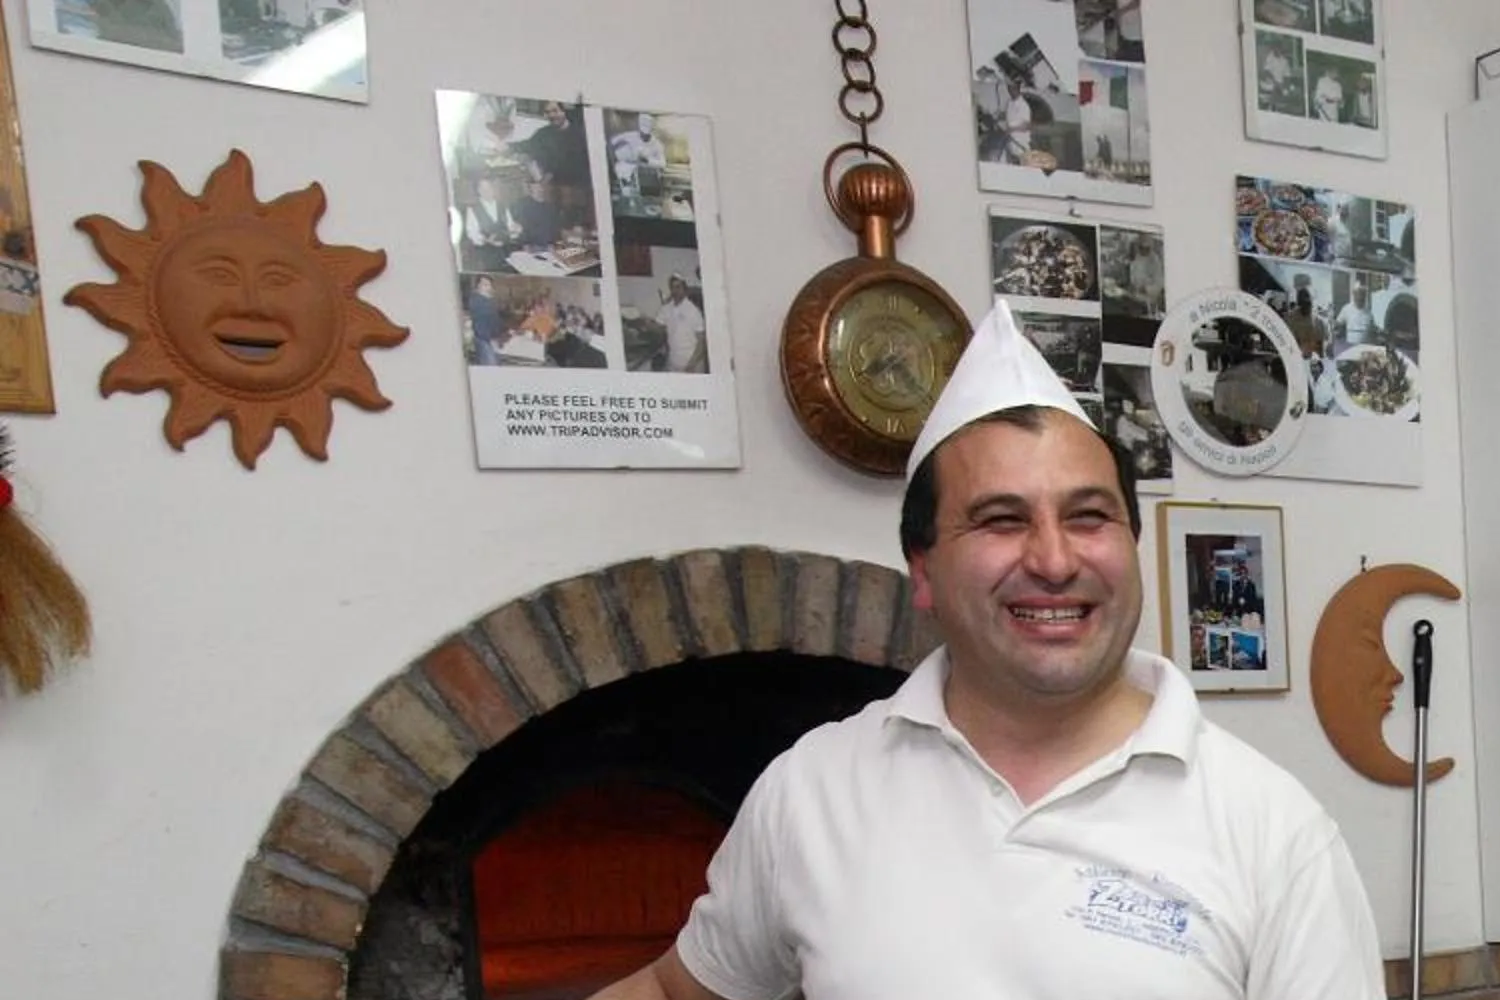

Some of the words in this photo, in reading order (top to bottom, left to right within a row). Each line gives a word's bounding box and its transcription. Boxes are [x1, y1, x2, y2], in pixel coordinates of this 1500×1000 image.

[504, 394, 559, 407] PLEASE
[563, 395, 596, 408] FEEL
[601, 396, 635, 409] FREE
[639, 397, 657, 410] TO
[661, 398, 709, 411] SUBMIT
[506, 409, 534, 421] ANY
[539, 410, 606, 423] PICTURES
[610, 411, 630, 423] ON
[633, 412, 651, 423] TO
[507, 425, 673, 439] WWW.TRIPADVISOR.COM
